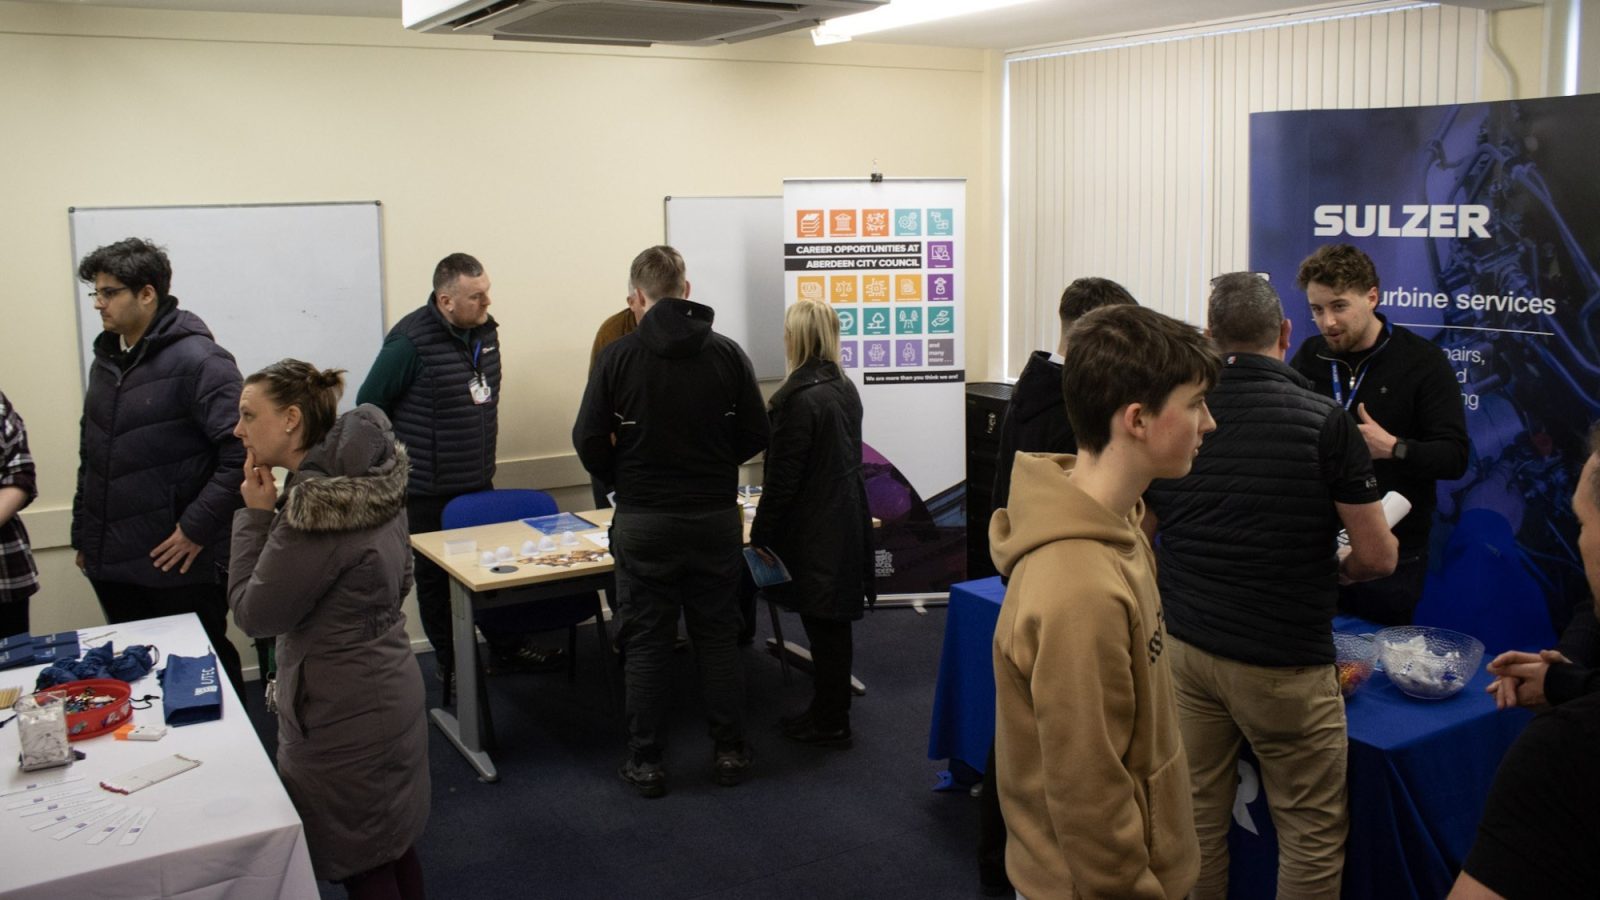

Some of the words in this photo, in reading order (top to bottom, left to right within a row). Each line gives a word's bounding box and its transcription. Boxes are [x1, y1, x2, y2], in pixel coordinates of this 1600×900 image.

[1314, 204, 1492, 238] SULZER
[796, 245, 832, 254] CAREER
[834, 244, 906, 254] OPPORTUNITIES
[907, 244, 920, 253] AT
[806, 259, 855, 269] ABERDEEN
[856, 259, 877, 267] CITY
[878, 258, 920, 267] COUNCIL
[1379, 286, 1449, 309] urbine
[1455, 290, 1557, 315] services
[1442, 345, 1486, 366] airs,
